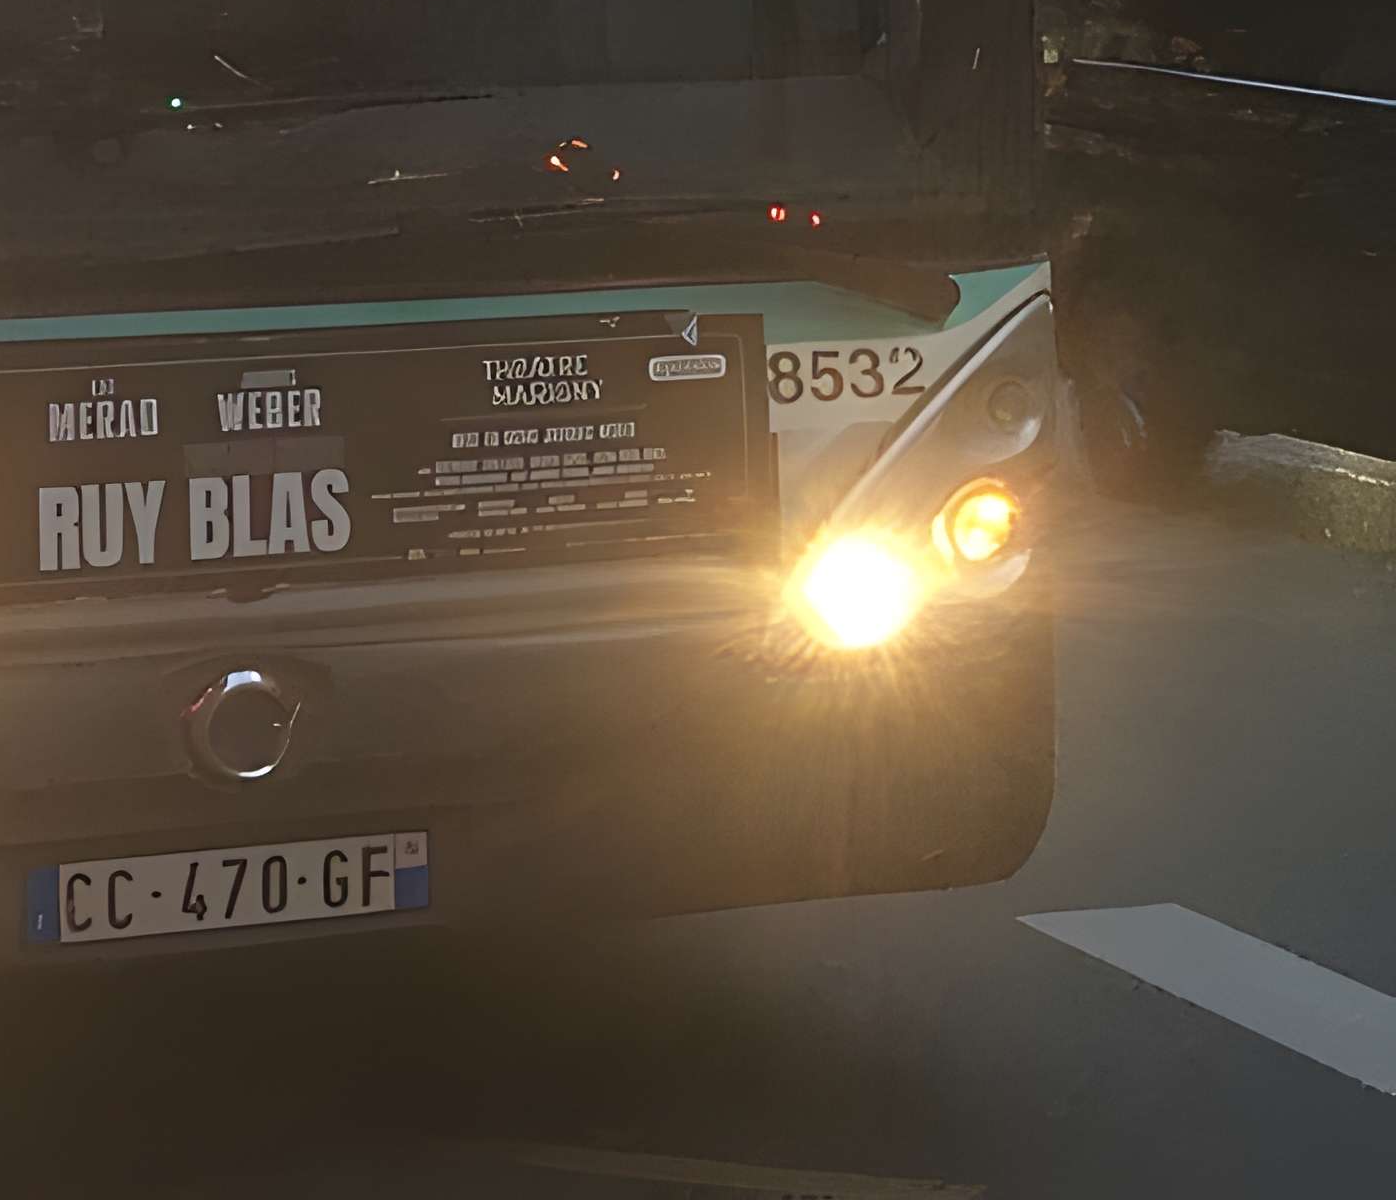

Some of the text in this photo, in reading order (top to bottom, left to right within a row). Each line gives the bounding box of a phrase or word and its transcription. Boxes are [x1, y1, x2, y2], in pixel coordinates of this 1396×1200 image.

[768, 346, 927, 405] 8532
[217, 388, 321, 432] WEBER
[39, 468, 352, 572] RUY BLAS
